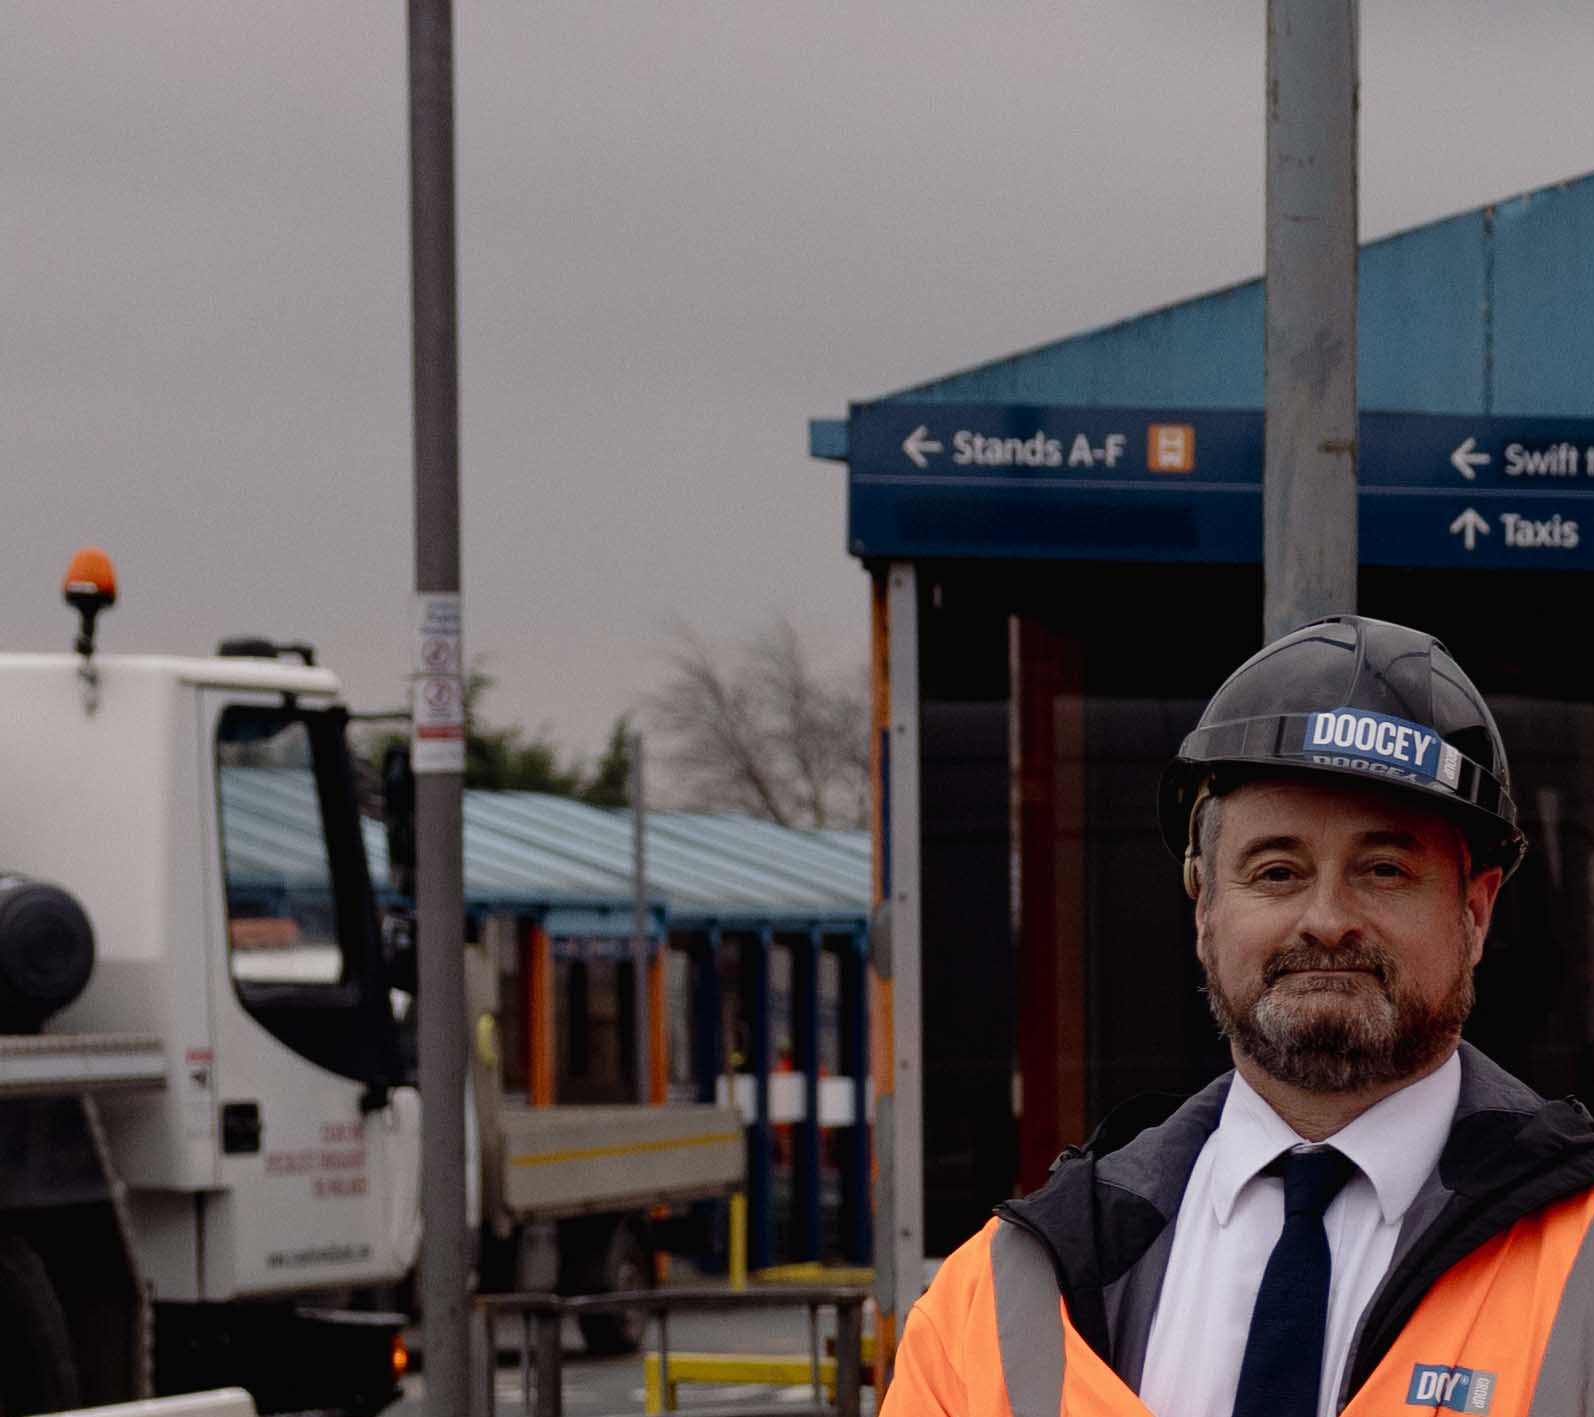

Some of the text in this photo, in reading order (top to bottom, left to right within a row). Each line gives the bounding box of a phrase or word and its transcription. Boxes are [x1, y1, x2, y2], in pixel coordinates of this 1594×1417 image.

[952, 430, 1126, 468] Stands A-F
[1504, 442, 1578, 476] Swift
[1500, 513, 1580, 548] Taxis
[1312, 713, 1432, 766] DOOCEY
[1472, 1376, 1490, 1410] GROUP
